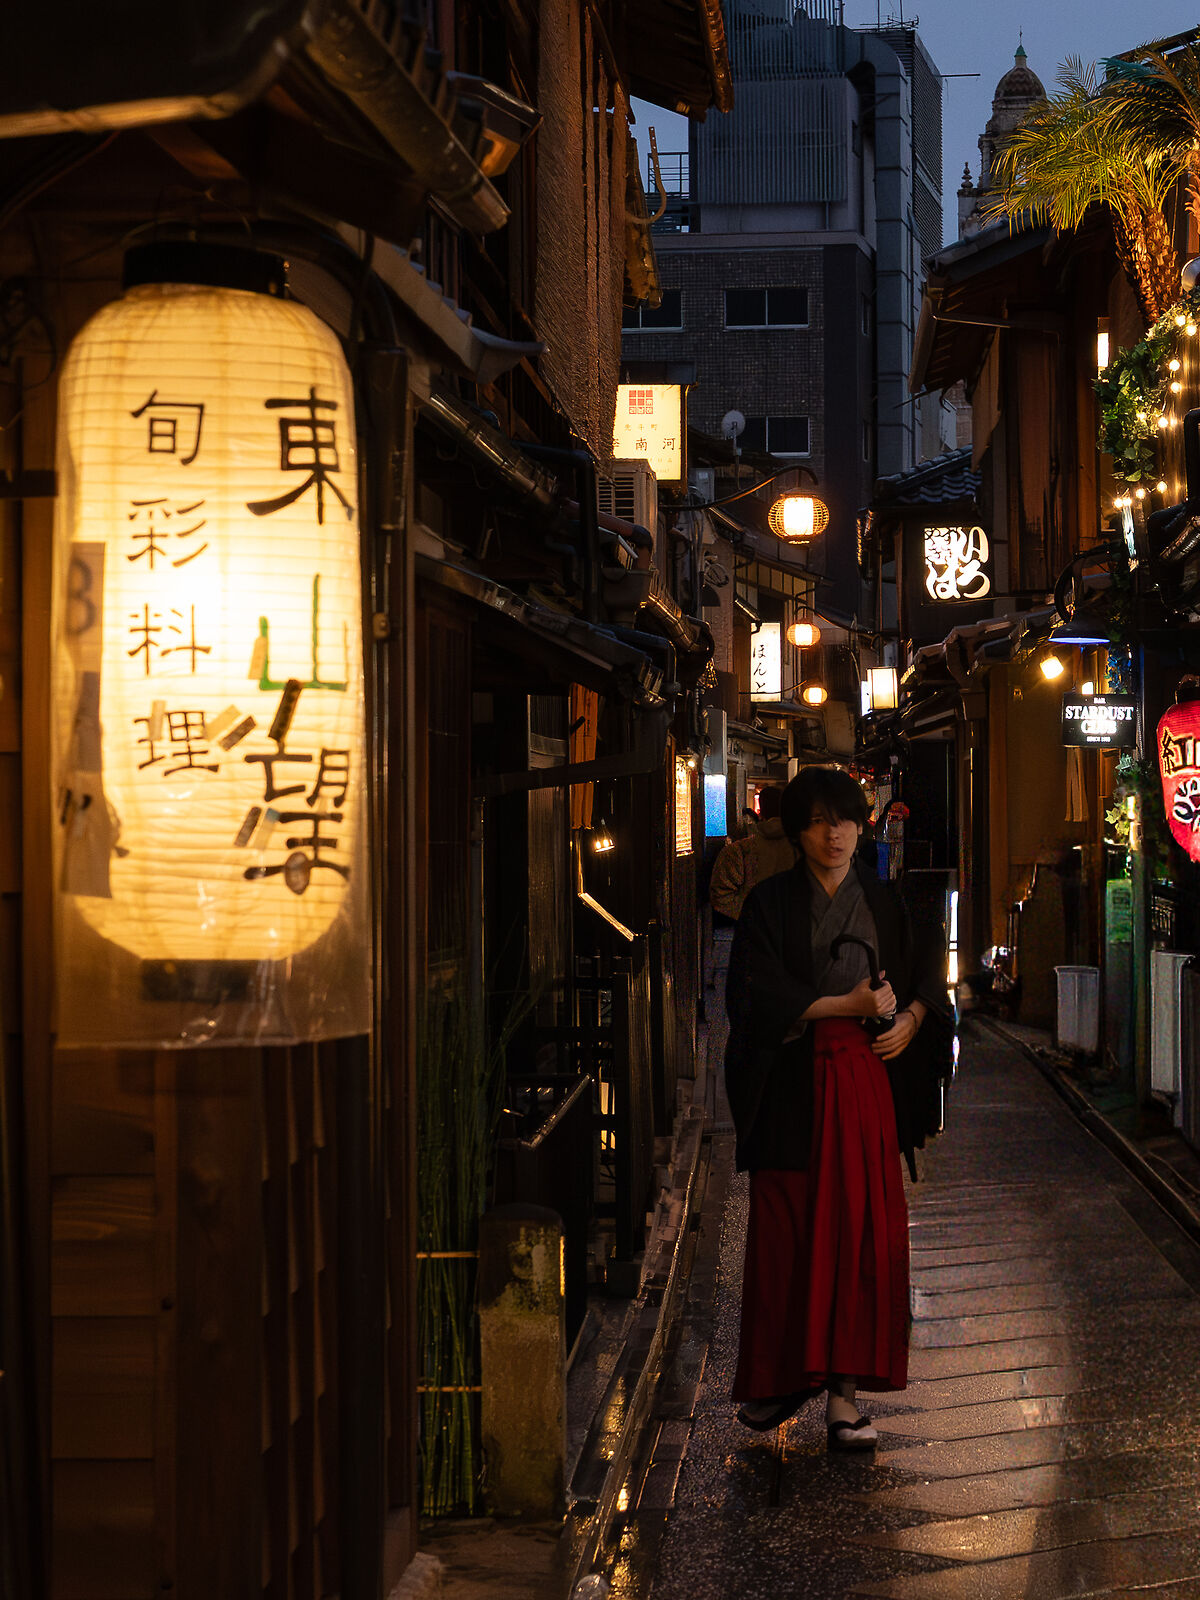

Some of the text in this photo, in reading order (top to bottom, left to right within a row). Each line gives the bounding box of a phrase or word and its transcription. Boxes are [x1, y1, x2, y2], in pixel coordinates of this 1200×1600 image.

[127, 387, 220, 776] 旬彩料理
[1065, 705, 1134, 720] STARDUST
[1081, 719, 1117, 734] CLUB
